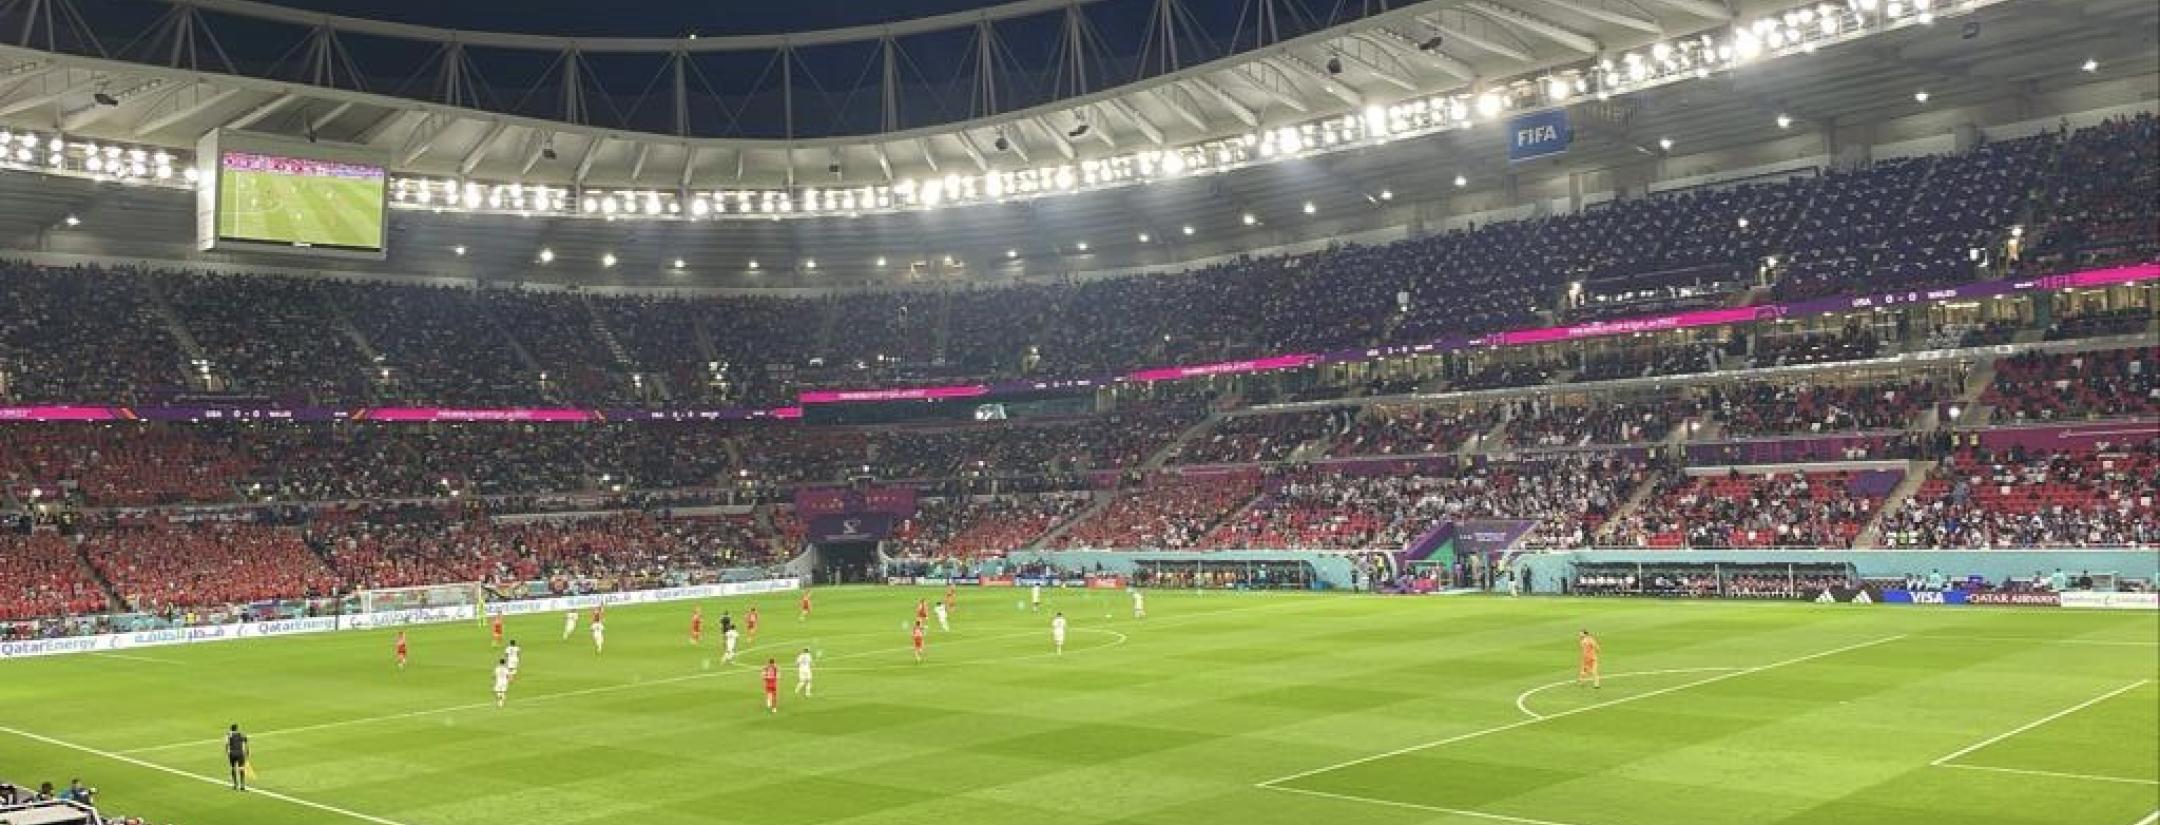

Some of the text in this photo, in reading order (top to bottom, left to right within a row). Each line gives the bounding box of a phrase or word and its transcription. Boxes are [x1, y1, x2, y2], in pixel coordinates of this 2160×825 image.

[1518, 125, 1558, 147] FIFA
[1911, 591, 1944, 604] VISA
[1970, 593, 2009, 603] QATAR
[1, 637, 97, 655] QatarEnergy
